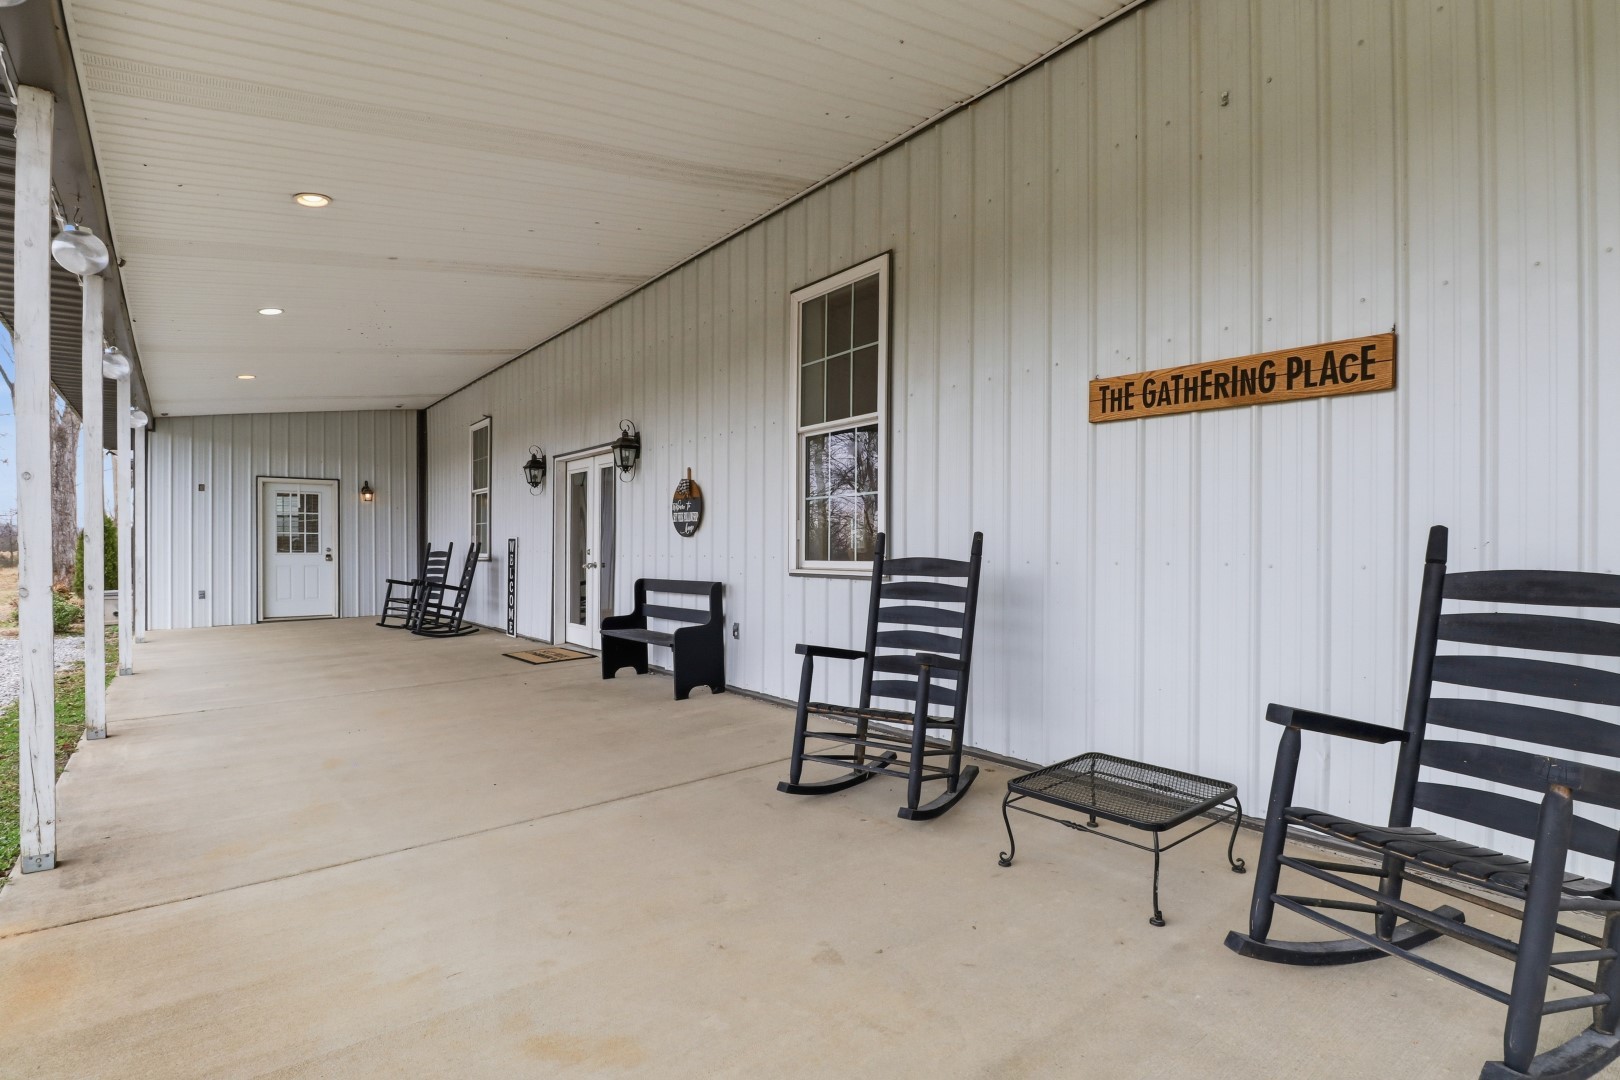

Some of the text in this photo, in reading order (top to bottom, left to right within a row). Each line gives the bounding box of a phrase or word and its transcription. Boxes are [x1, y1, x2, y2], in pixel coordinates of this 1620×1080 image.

[1099, 344, 1377, 414] THE GATHERING PLACE
